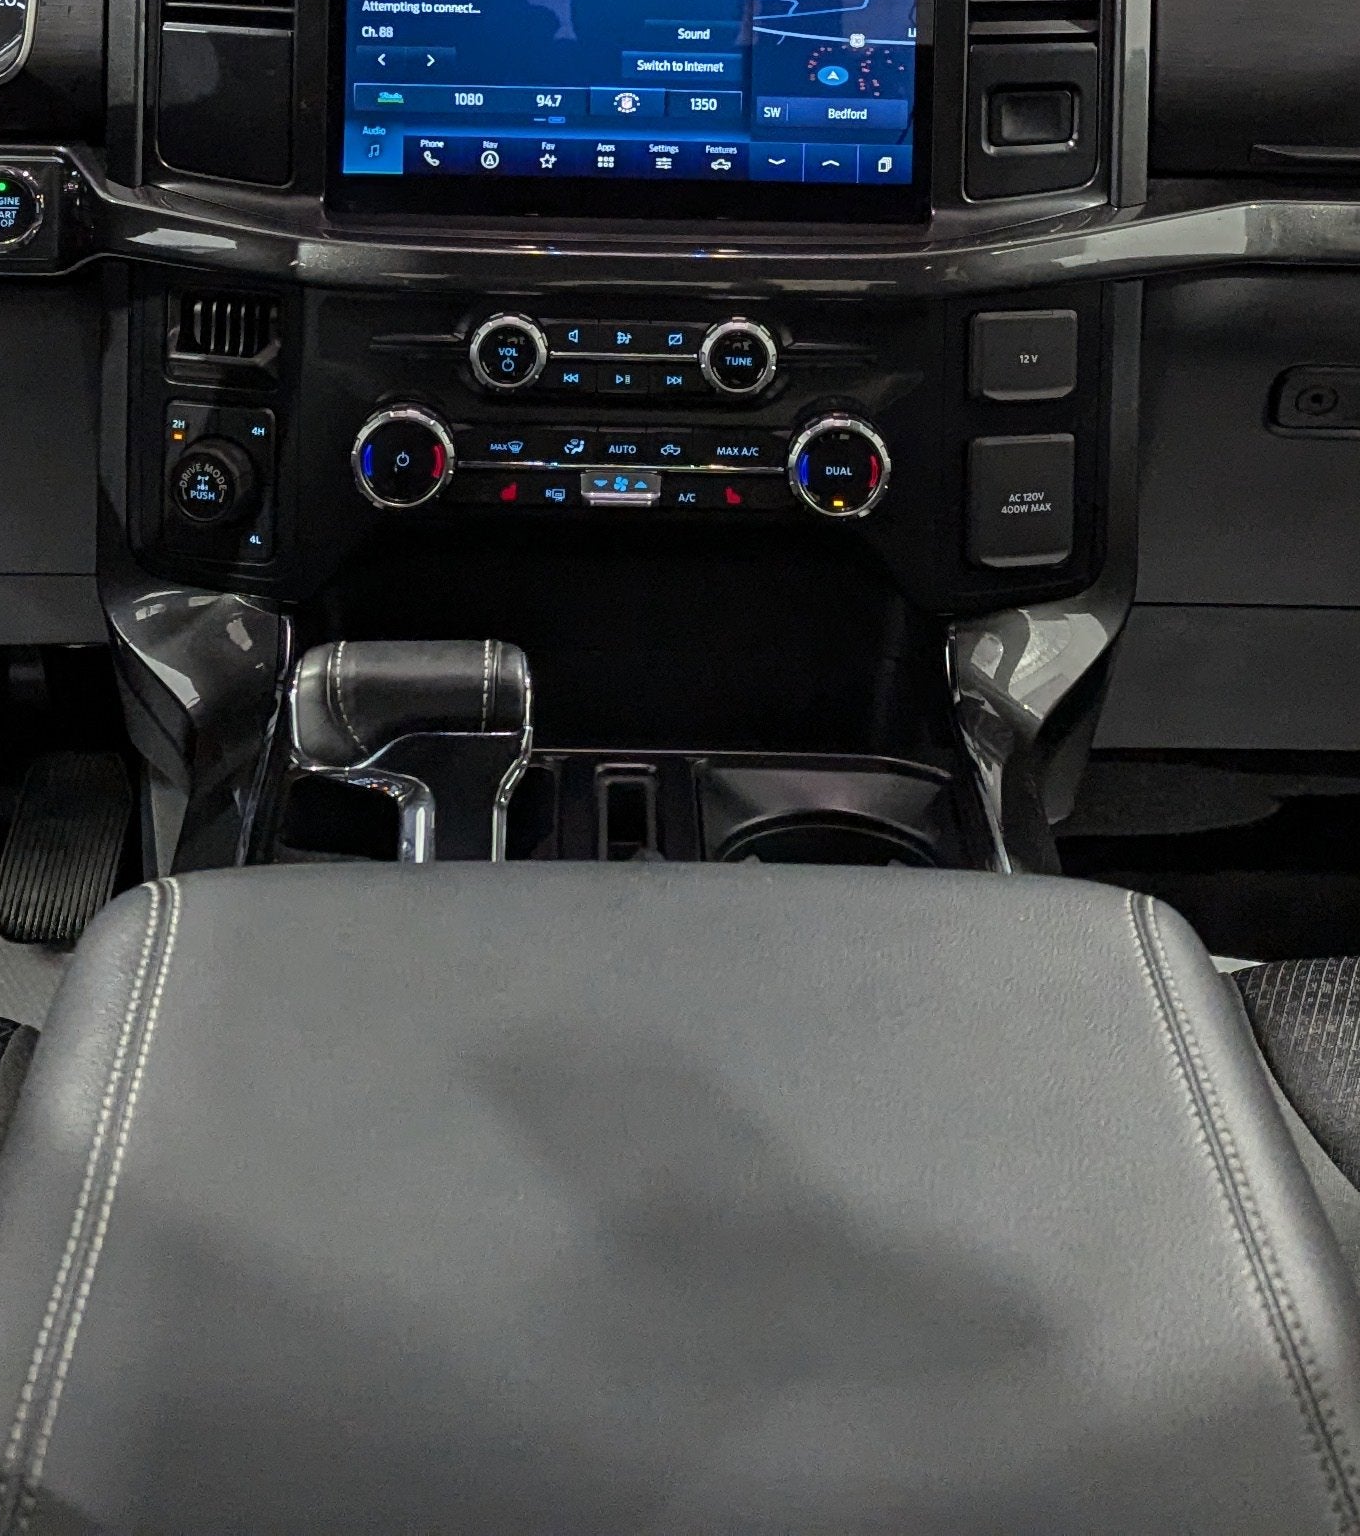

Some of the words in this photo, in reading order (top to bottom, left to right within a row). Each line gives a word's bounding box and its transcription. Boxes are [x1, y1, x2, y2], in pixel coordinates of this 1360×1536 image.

[362, 1, 420, 15] Attempting
[421, 3, 433, 14] to
[677, 27, 711, 40] Sound
[637, 59, 670, 72] Switch
[672, 60, 683, 72] to
[684, 61, 724, 73] Internet
[454, 92, 484, 106] 1080
[536, 94, 562, 108] 94.7
[690, 98, 717, 111] 1350
[764, 106, 781, 118] SW
[828, 107, 867, 121] Bedford
[362, 125, 386, 136] Audio
[420, 138, 444, 149] Phone
[482, 140, 498, 149] Nav
[541, 141, 556, 151] Fav
[596, 142, 616, 153] Apps
[648, 143, 679, 154] Settings
[705, 144, 737, 155] Features
[498, 347, 519, 357] VOL
[724, 356, 753, 367] TUNE
[1019, 354, 1030, 364] 12
[1030, 354, 1039, 364] V
[172, 419, 185, 429] 2H
[251, 426, 265, 437] 4H
[608, 444, 637, 455] AUTO
[716, 446, 739, 457] MAX
[740, 445, 760, 458] A/C
[825, 465, 853, 477] DUAL
[179, 463, 202, 488] DRIVE
[203, 463, 228, 491] MODE
[190, 490, 215, 500] PUSH
[678, 491, 697, 503] A/C
[1008, 493, 1022, 503] AC
[1023, 491, 1045, 502] 120V
[1000, 504, 1029, 514] 400W
[1030, 502, 1052, 513] MAX
[249, 535, 262, 545] 4L
